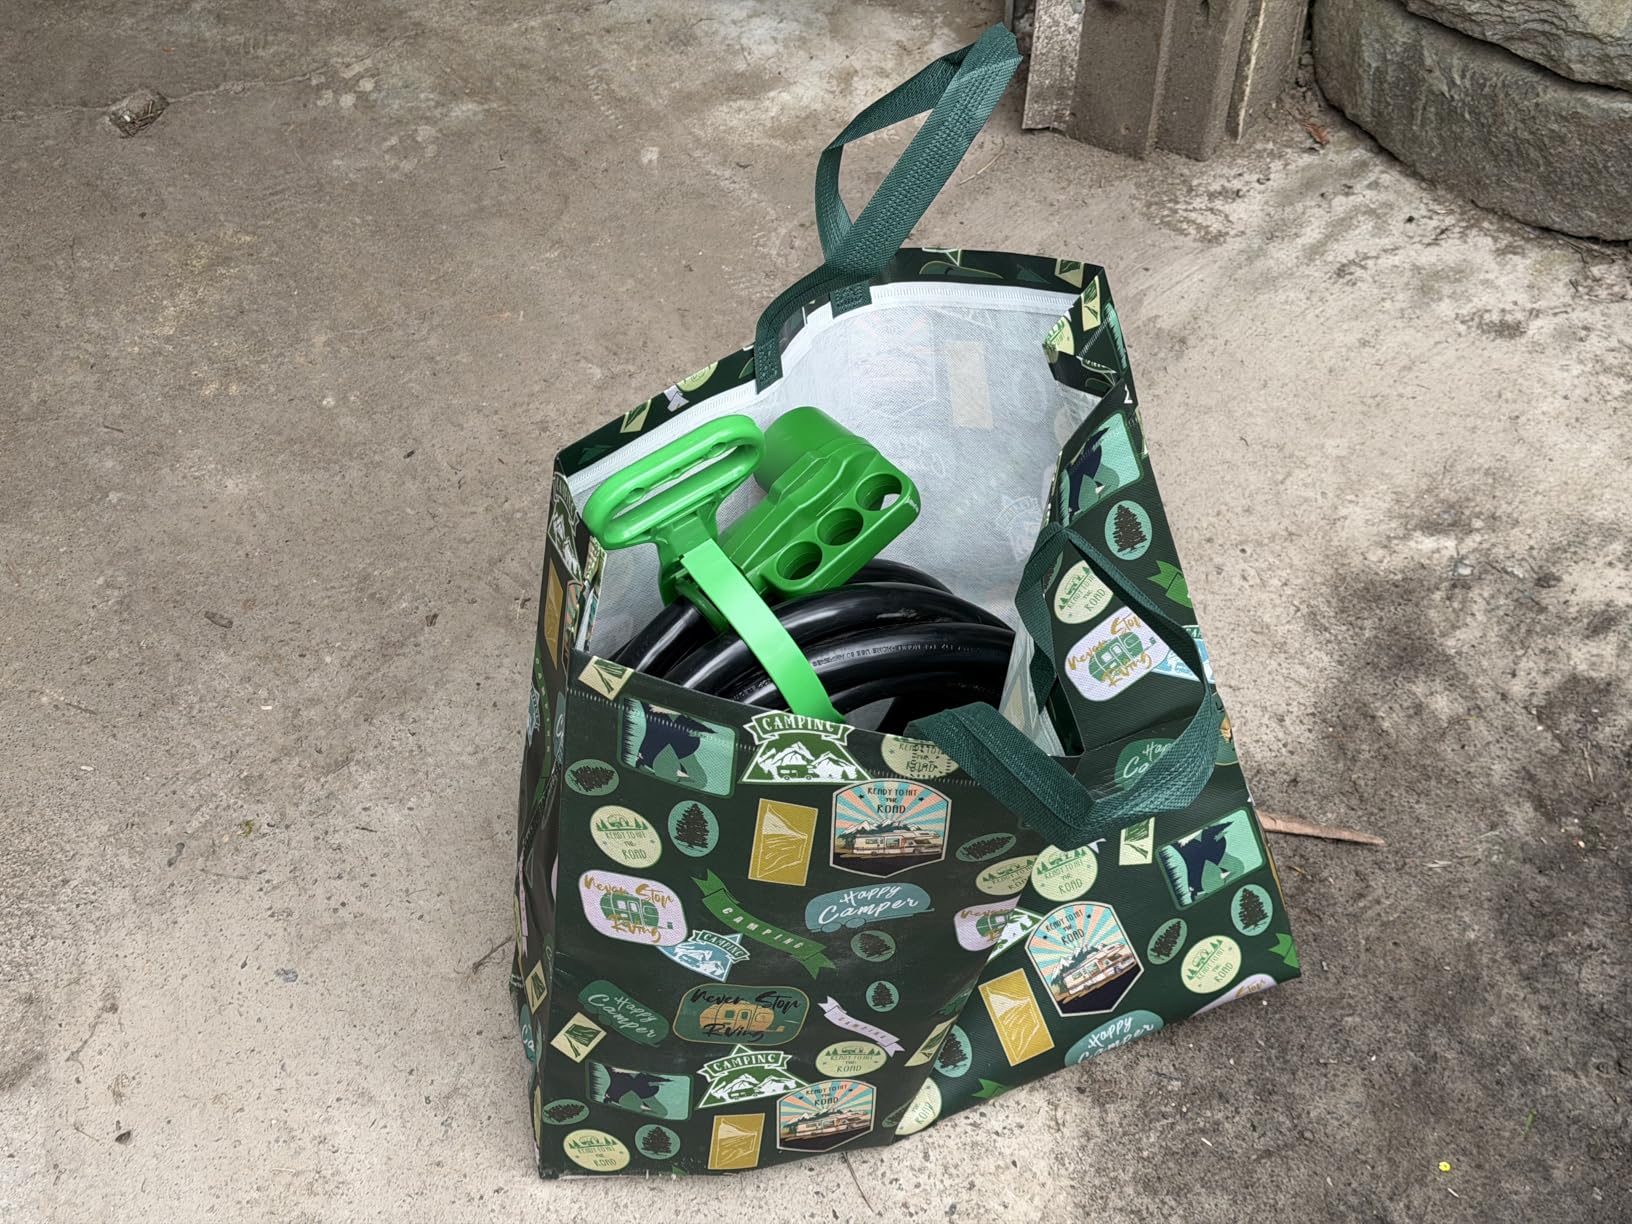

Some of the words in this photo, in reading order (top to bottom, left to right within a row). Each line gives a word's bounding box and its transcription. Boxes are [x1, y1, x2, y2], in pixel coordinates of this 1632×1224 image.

[762, 715, 834, 732] CAMPING
[868, 788, 892, 796] READY
[905, 789, 917, 797] HIT
[877, 805, 906, 813] ROAD
[622, 849, 647, 859] ROAD
[840, 885, 902, 906] Happy
[1058, 878, 1083, 894] ROAD
[818, 897, 919, 924] Camper
[722, 907, 804, 949] CAMPING
[1061, 928, 1084, 945] ROAD
[704, 933, 744, 957] CAMPING
[588, 994, 657, 1038] Camper
[614, 996, 657, 1022] Happy
[1087, 1016, 1134, 1049] Happy
[713, 1054, 776, 1071] CAMPING
